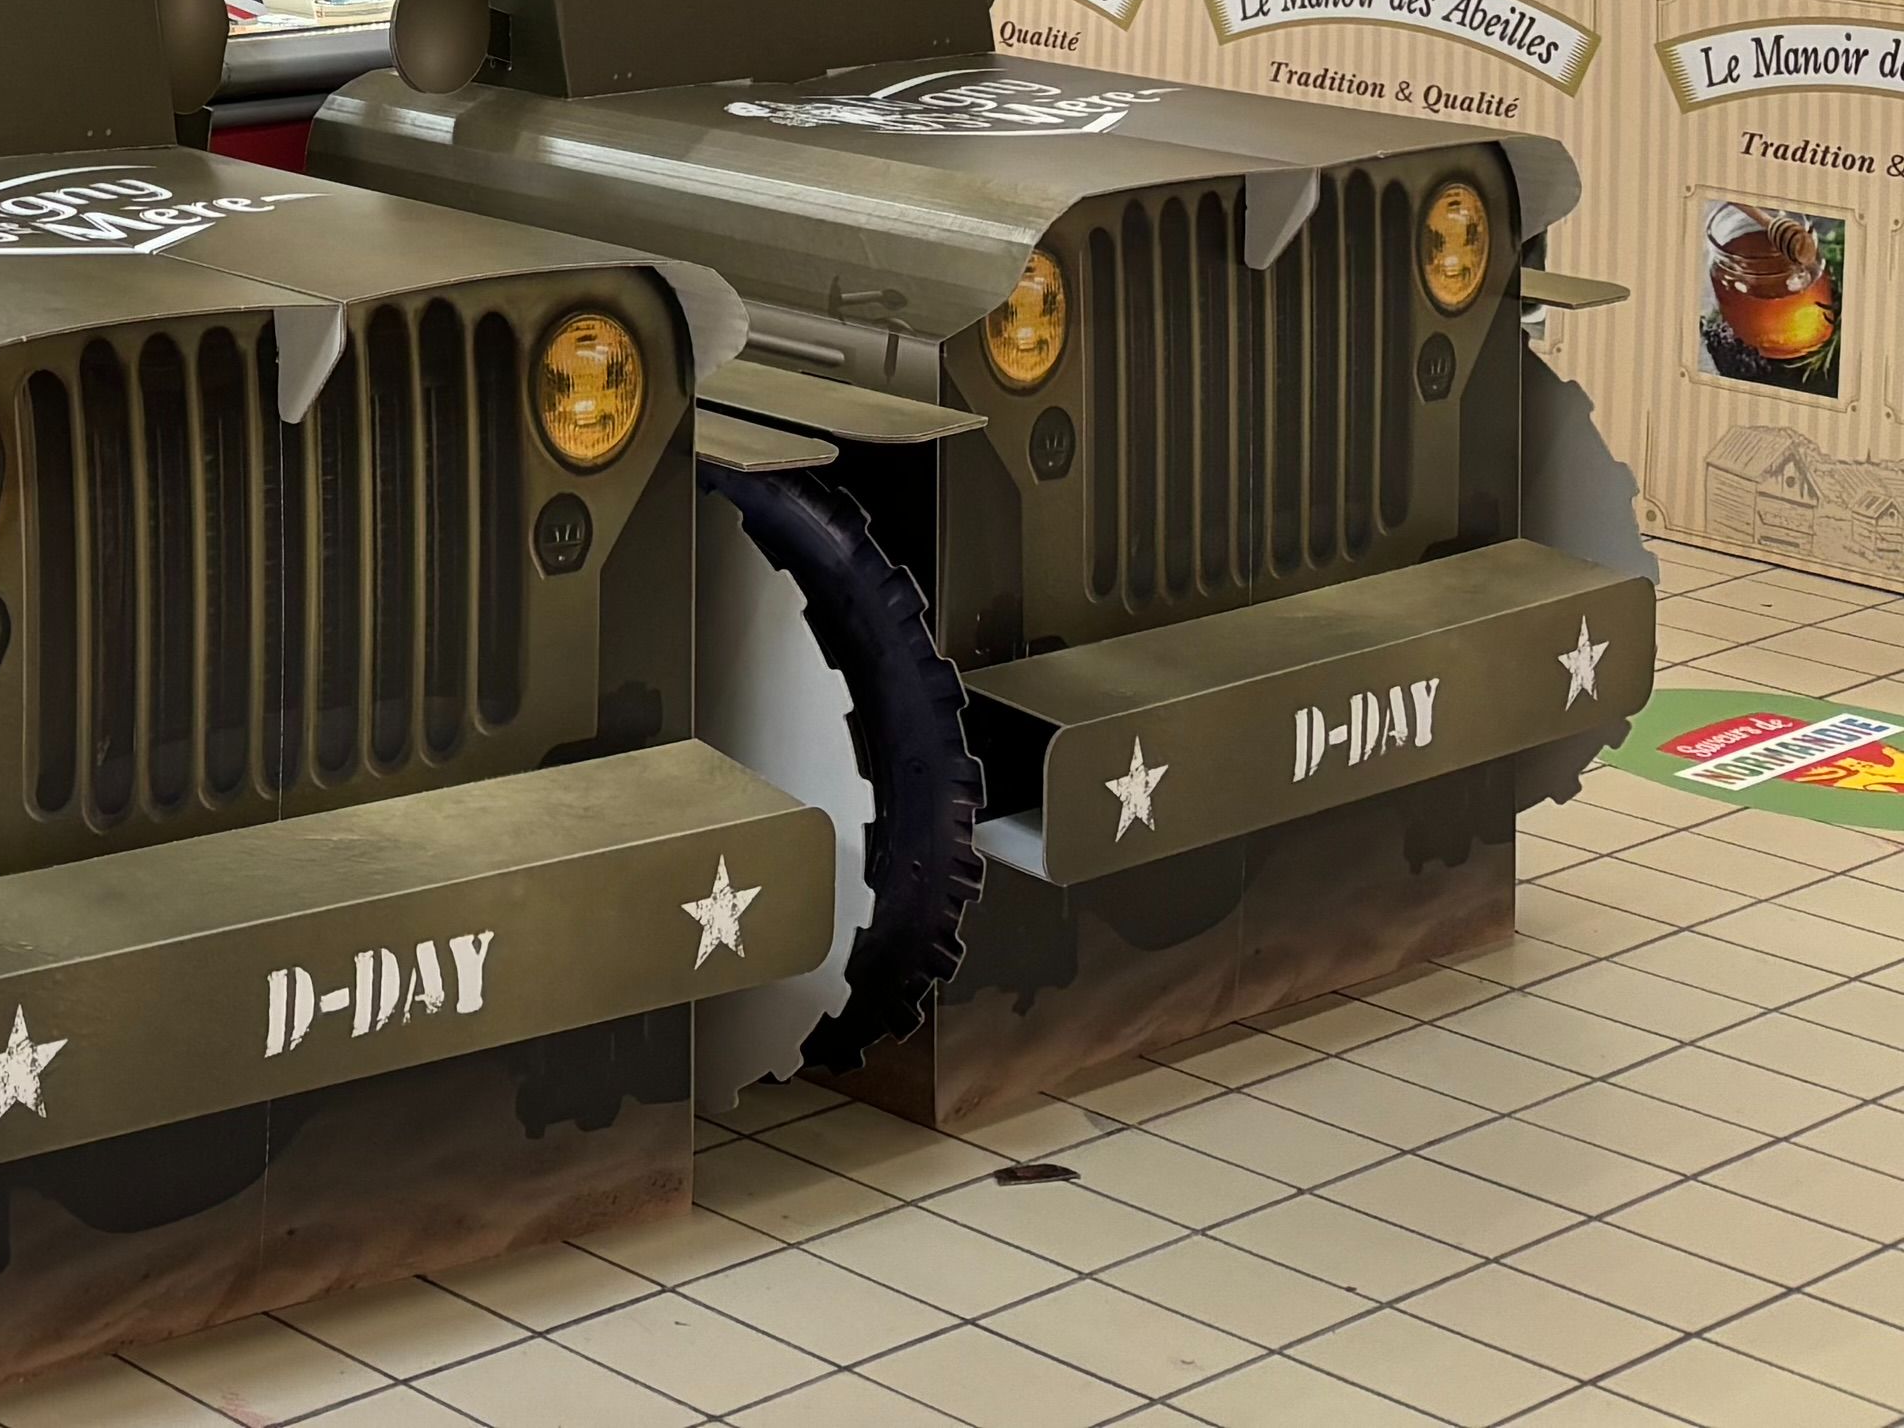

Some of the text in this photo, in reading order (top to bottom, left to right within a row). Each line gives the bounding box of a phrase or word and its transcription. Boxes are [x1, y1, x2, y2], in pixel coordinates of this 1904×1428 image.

[998, 20, 1082, 54] Qualité
[1700, 31, 1870, 89] Le Manoir
[1269, 59, 1520, 121] Tradition & Qualité
[1740, 130, 1876, 175] Tradition
[1292, 678, 1441, 784] D-DAY
[1676, 717, 1794, 759] Saveurs de
[1691, 717, 1890, 785] NORMANDIE
[264, 929, 495, 1060] D-DAY
